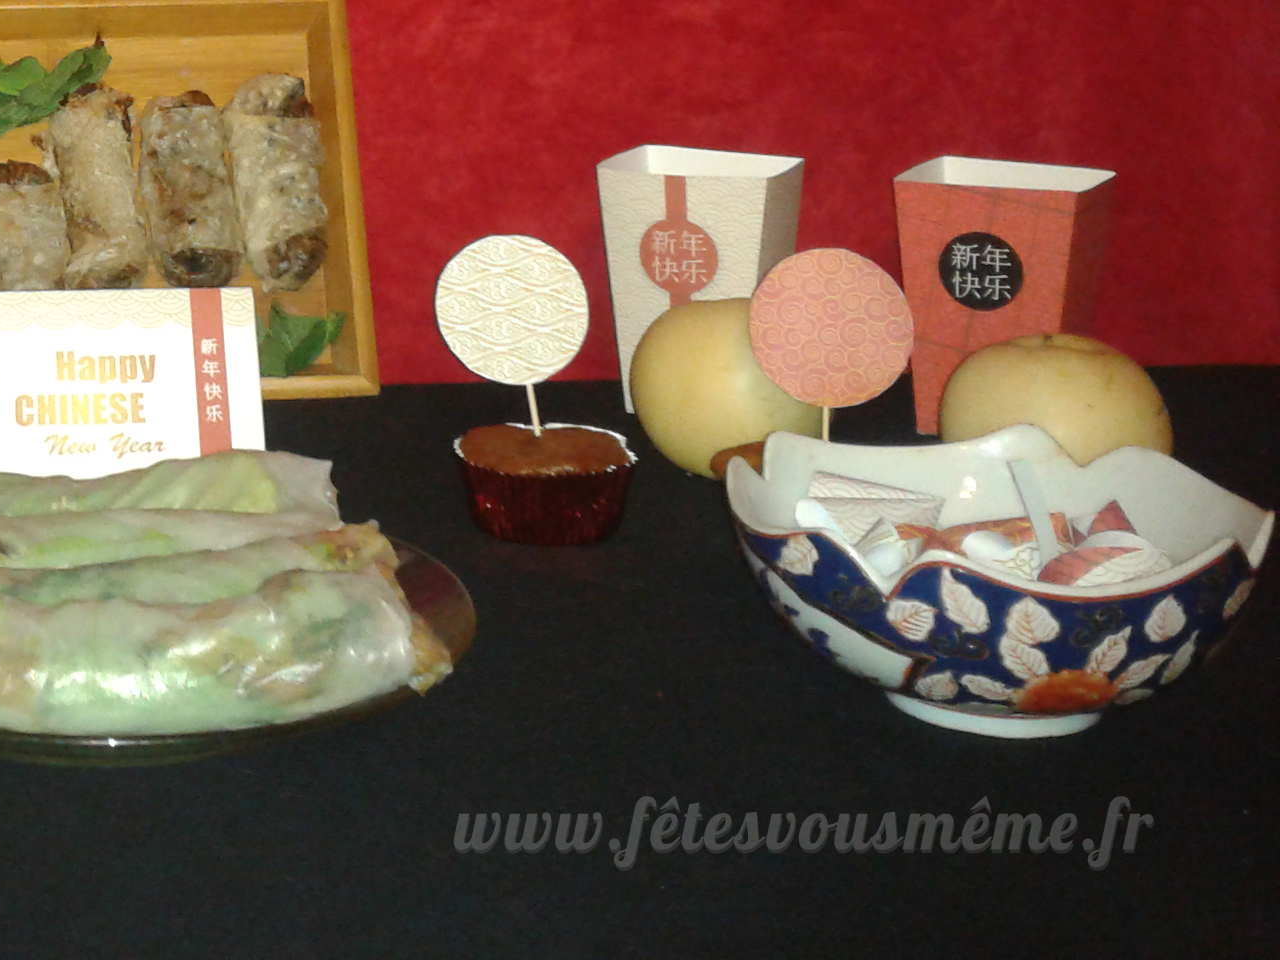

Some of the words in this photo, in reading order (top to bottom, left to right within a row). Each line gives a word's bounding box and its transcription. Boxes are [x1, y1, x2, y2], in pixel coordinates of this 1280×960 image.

[651, 229, 708, 257] 新年
[950, 242, 1013, 273] 新年
[651, 256, 708, 284] 快乐
[950, 270, 1013, 300] 快乐
[55, 350, 157, 384] Happy
[200, 337, 224, 423] 新年快乐
[14, 392, 147, 427] CHINESE
[43, 433, 97, 456] New
[108, 431, 167, 460] Year
